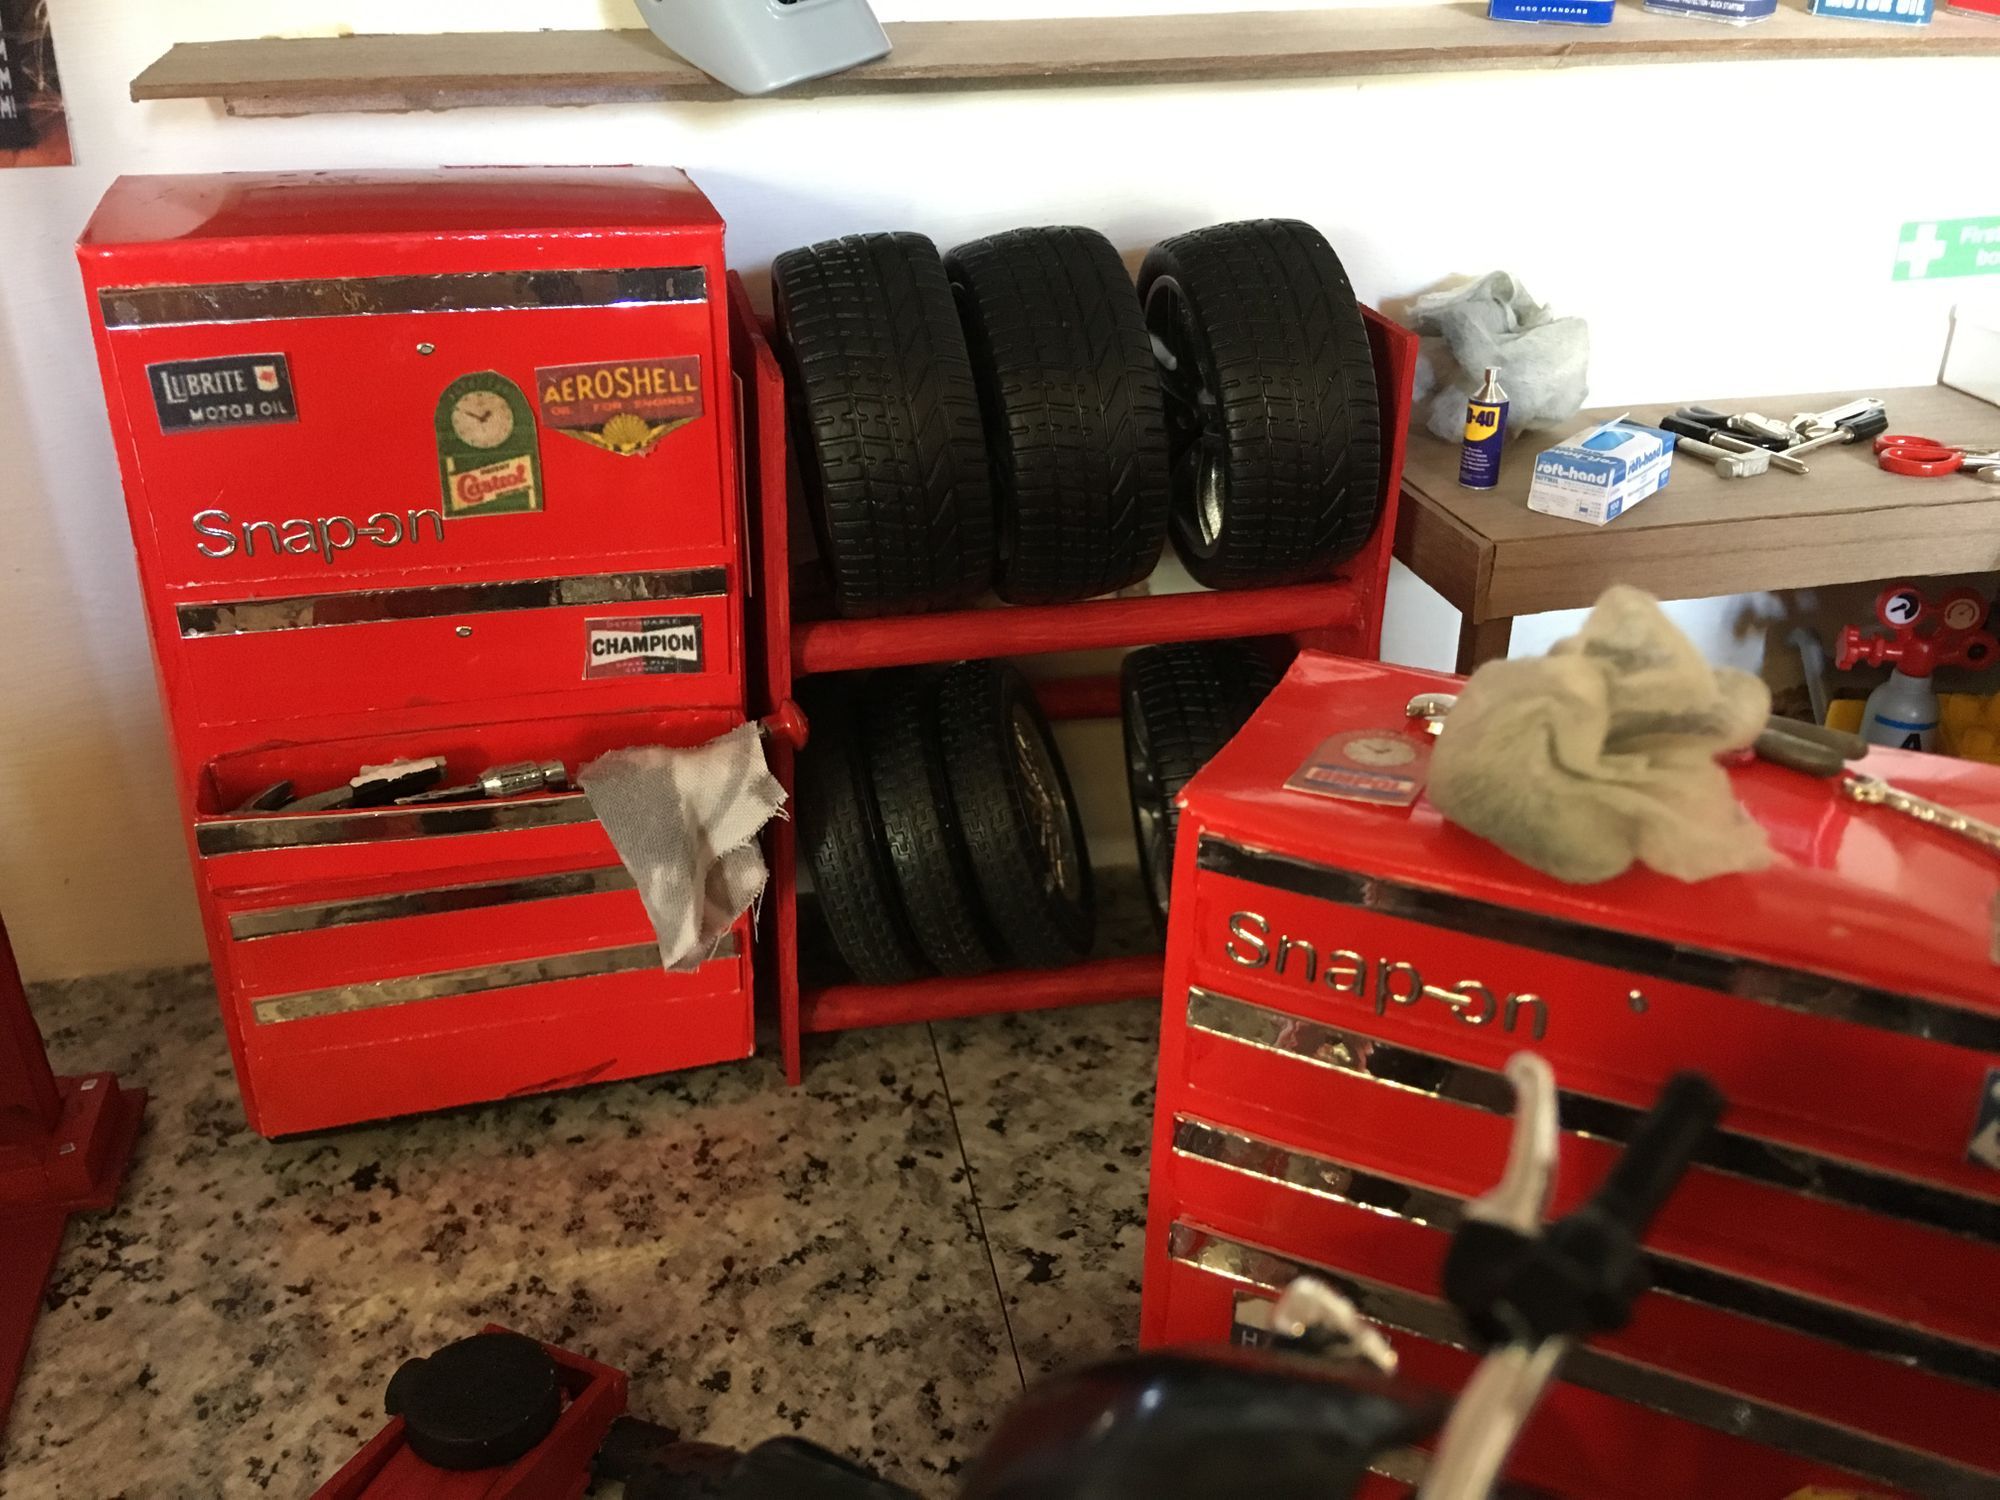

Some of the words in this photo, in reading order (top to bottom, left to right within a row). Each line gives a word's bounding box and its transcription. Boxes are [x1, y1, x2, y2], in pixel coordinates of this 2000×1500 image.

[1541, 6, 1588, 15] STANDARD
[159, 370, 248, 404] LUBRITE
[543, 366, 699, 404] AEROSHELL
[189, 404, 255, 422] MOTOR
[259, 400, 288, 416] OIL
[592, 401, 622, 413] FOR
[456, 463, 527, 504] Castrol
[1536, 462, 1607, 485] soft-hand
[193, 509, 446, 564] Snap-on
[592, 633, 696, 656] CHAMPION
[1225, 910, 1548, 1041] Snap-on
